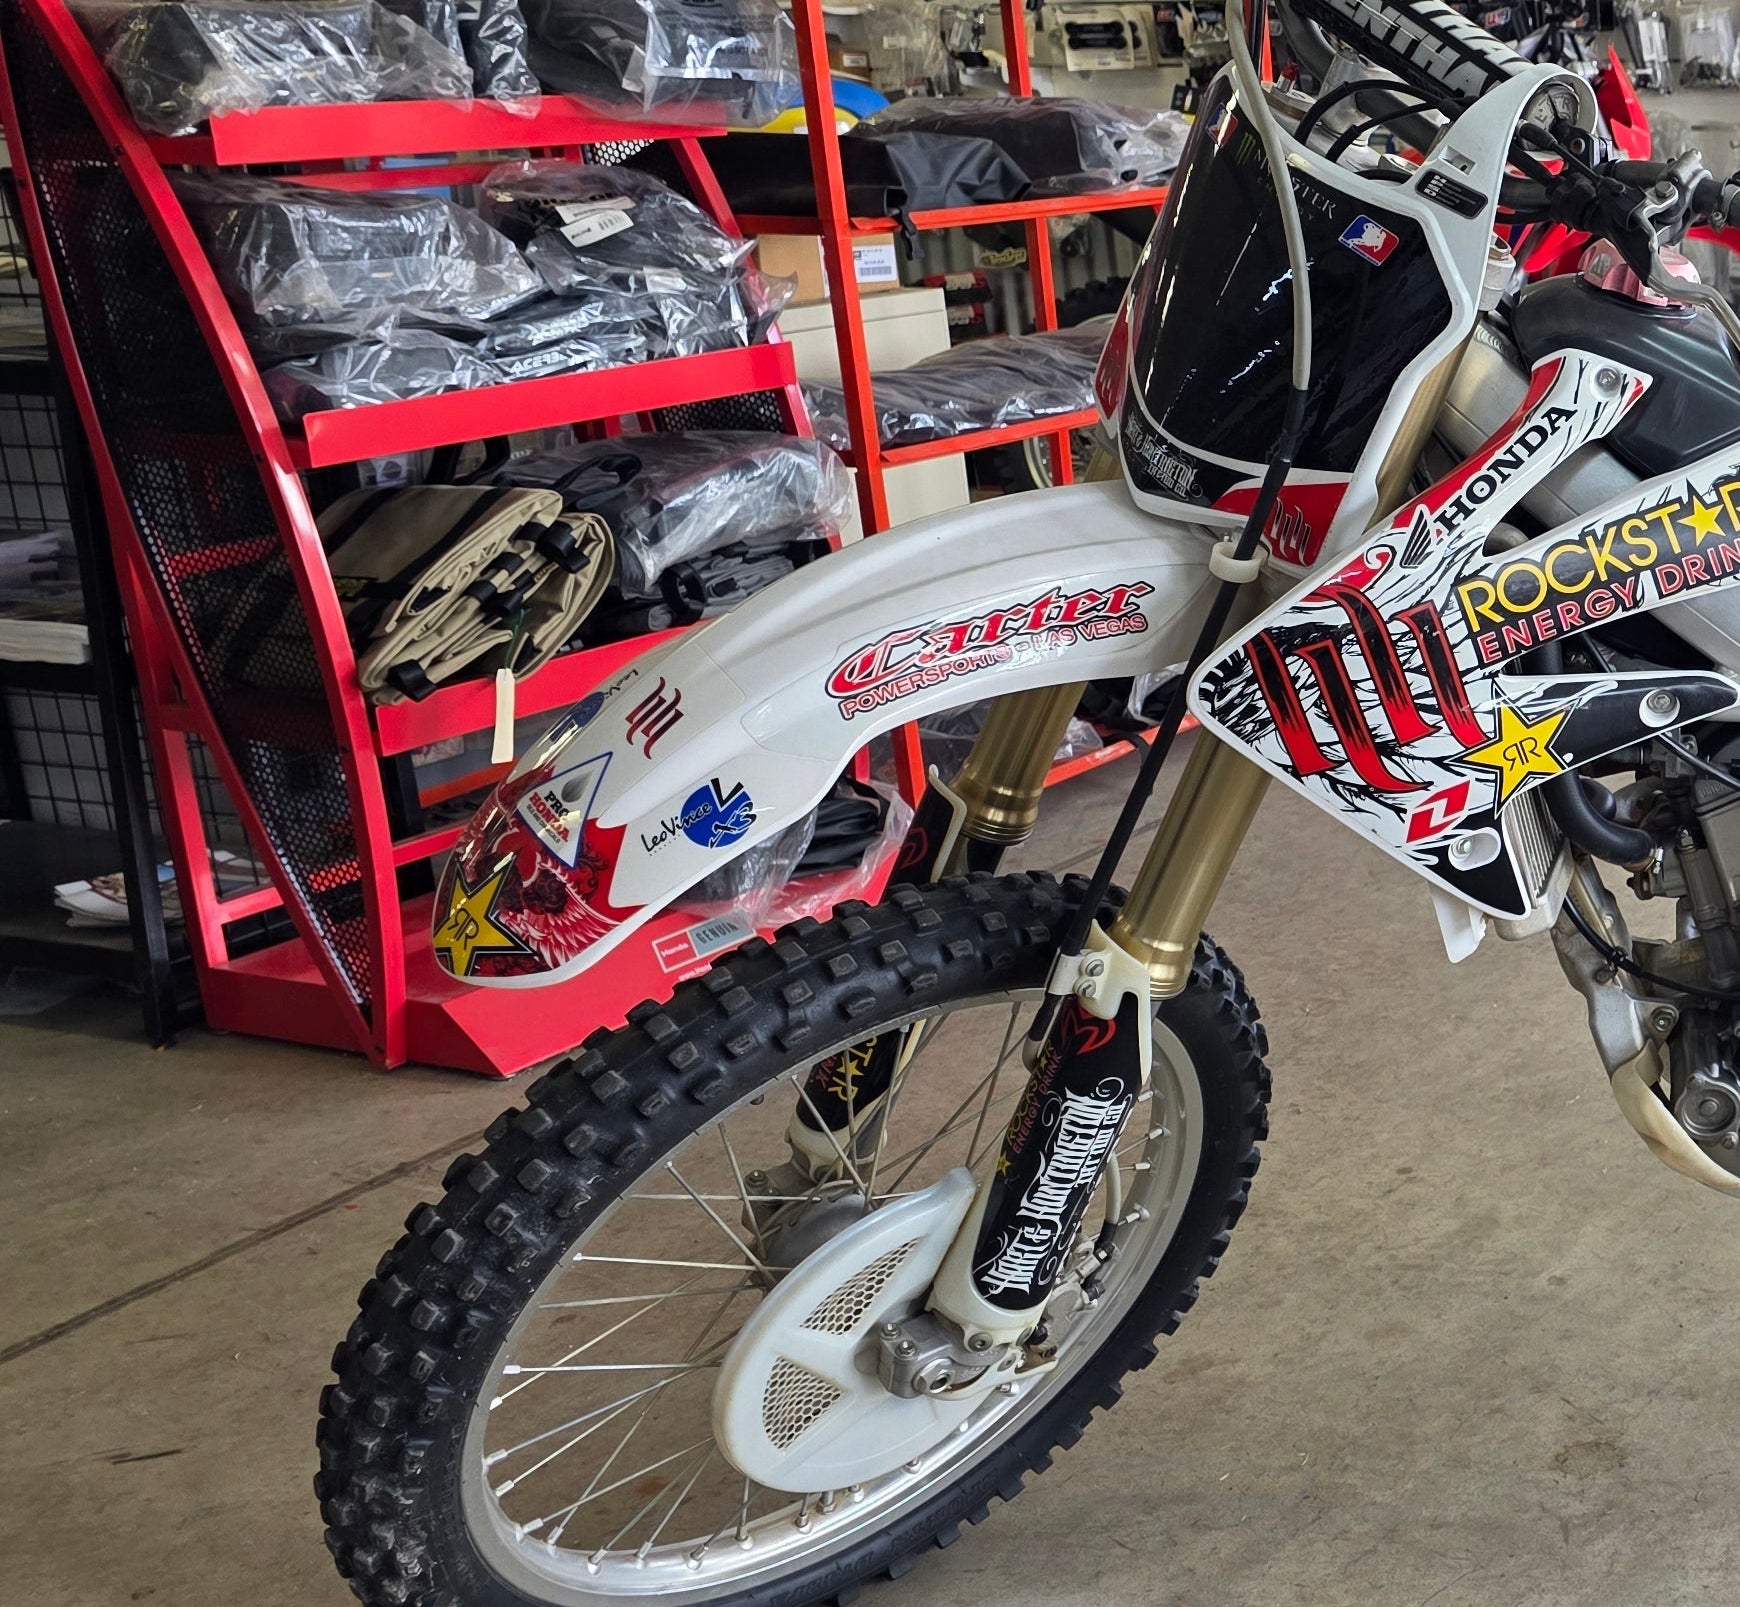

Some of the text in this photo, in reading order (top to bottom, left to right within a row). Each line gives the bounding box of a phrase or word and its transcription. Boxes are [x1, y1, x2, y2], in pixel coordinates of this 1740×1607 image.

[1434, 403, 1578, 544] HONDA
[825, 581, 1155, 698] Carter
[1077, 613, 1150, 643] VEGAS
[1478, 576, 1638, 667] ENERGY
[640, 801, 714, 853] LeoVince
